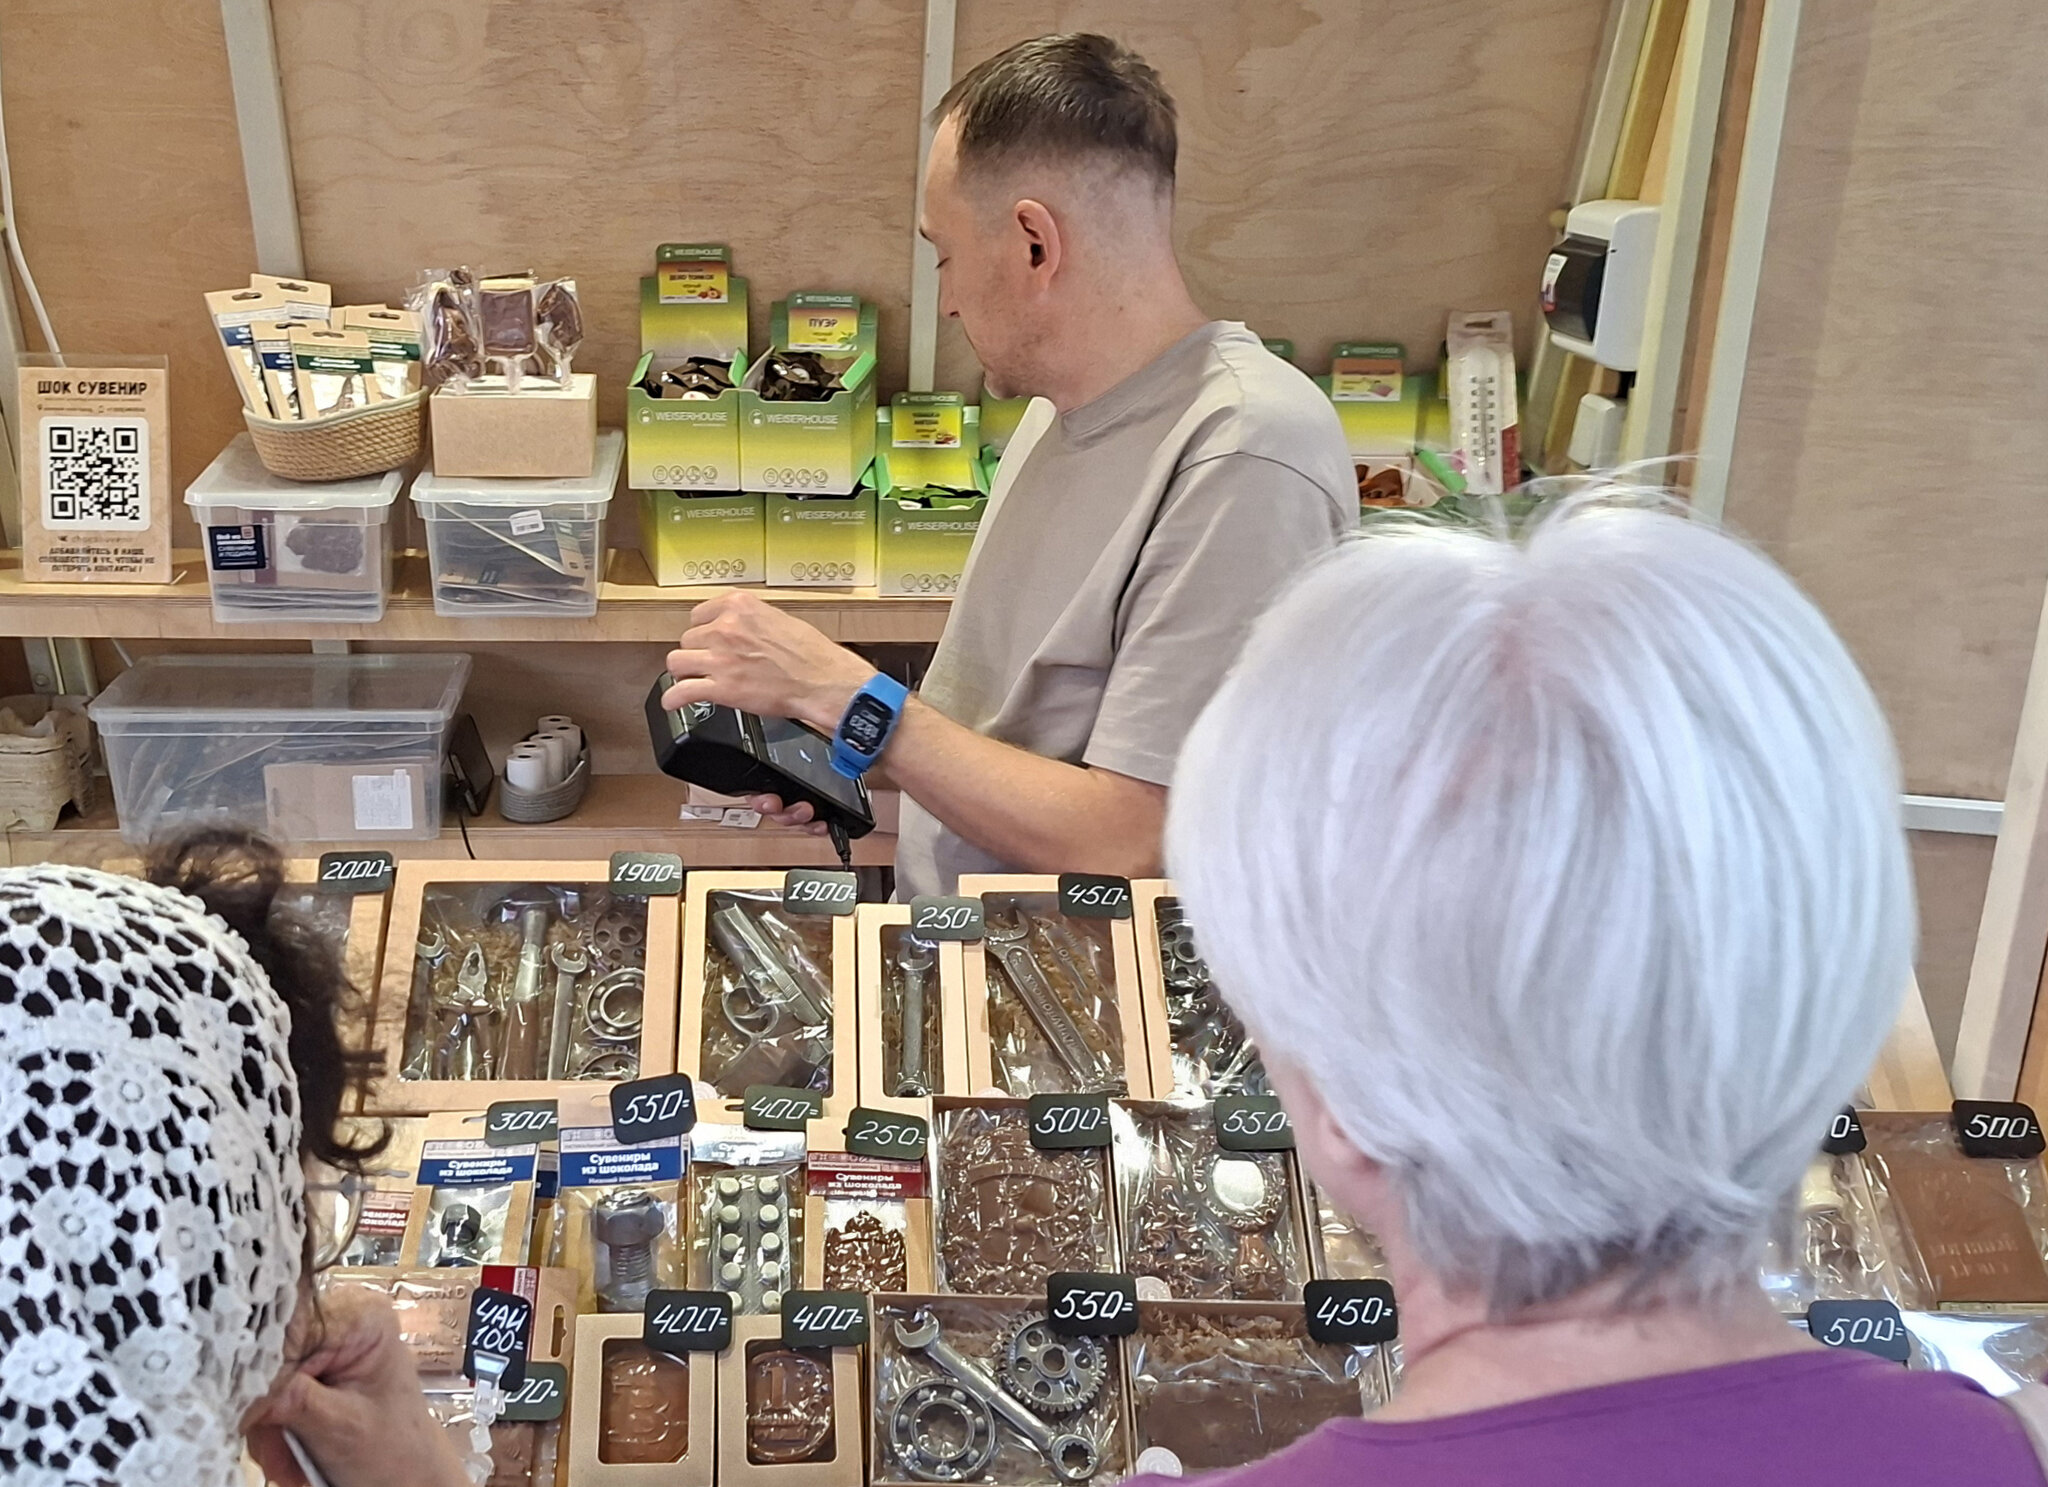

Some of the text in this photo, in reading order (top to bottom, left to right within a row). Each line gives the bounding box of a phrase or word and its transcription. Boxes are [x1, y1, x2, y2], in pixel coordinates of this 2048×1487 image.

[808, 318, 838, 328] ПУЭР
[37, 380, 148, 396] ШОК СУВЕНИР
[655, 411, 728, 422] WEISERHOUSE
[766, 414, 839, 425] WEISERHOUSE
[687, 506, 756, 519] WEISERHOUSE
[795, 510, 867, 520] WEISERHOUSE
[448, 1159, 507, 1170] Сувениры
[589, 1152, 651, 1166] Сувениры
[438, 1166, 514, 1177] из шоколада
[581, 1162, 660, 1176] из шоколада
[835, 1172, 894, 1182] Сувениры
[844, 1181, 902, 1189] шоколада
